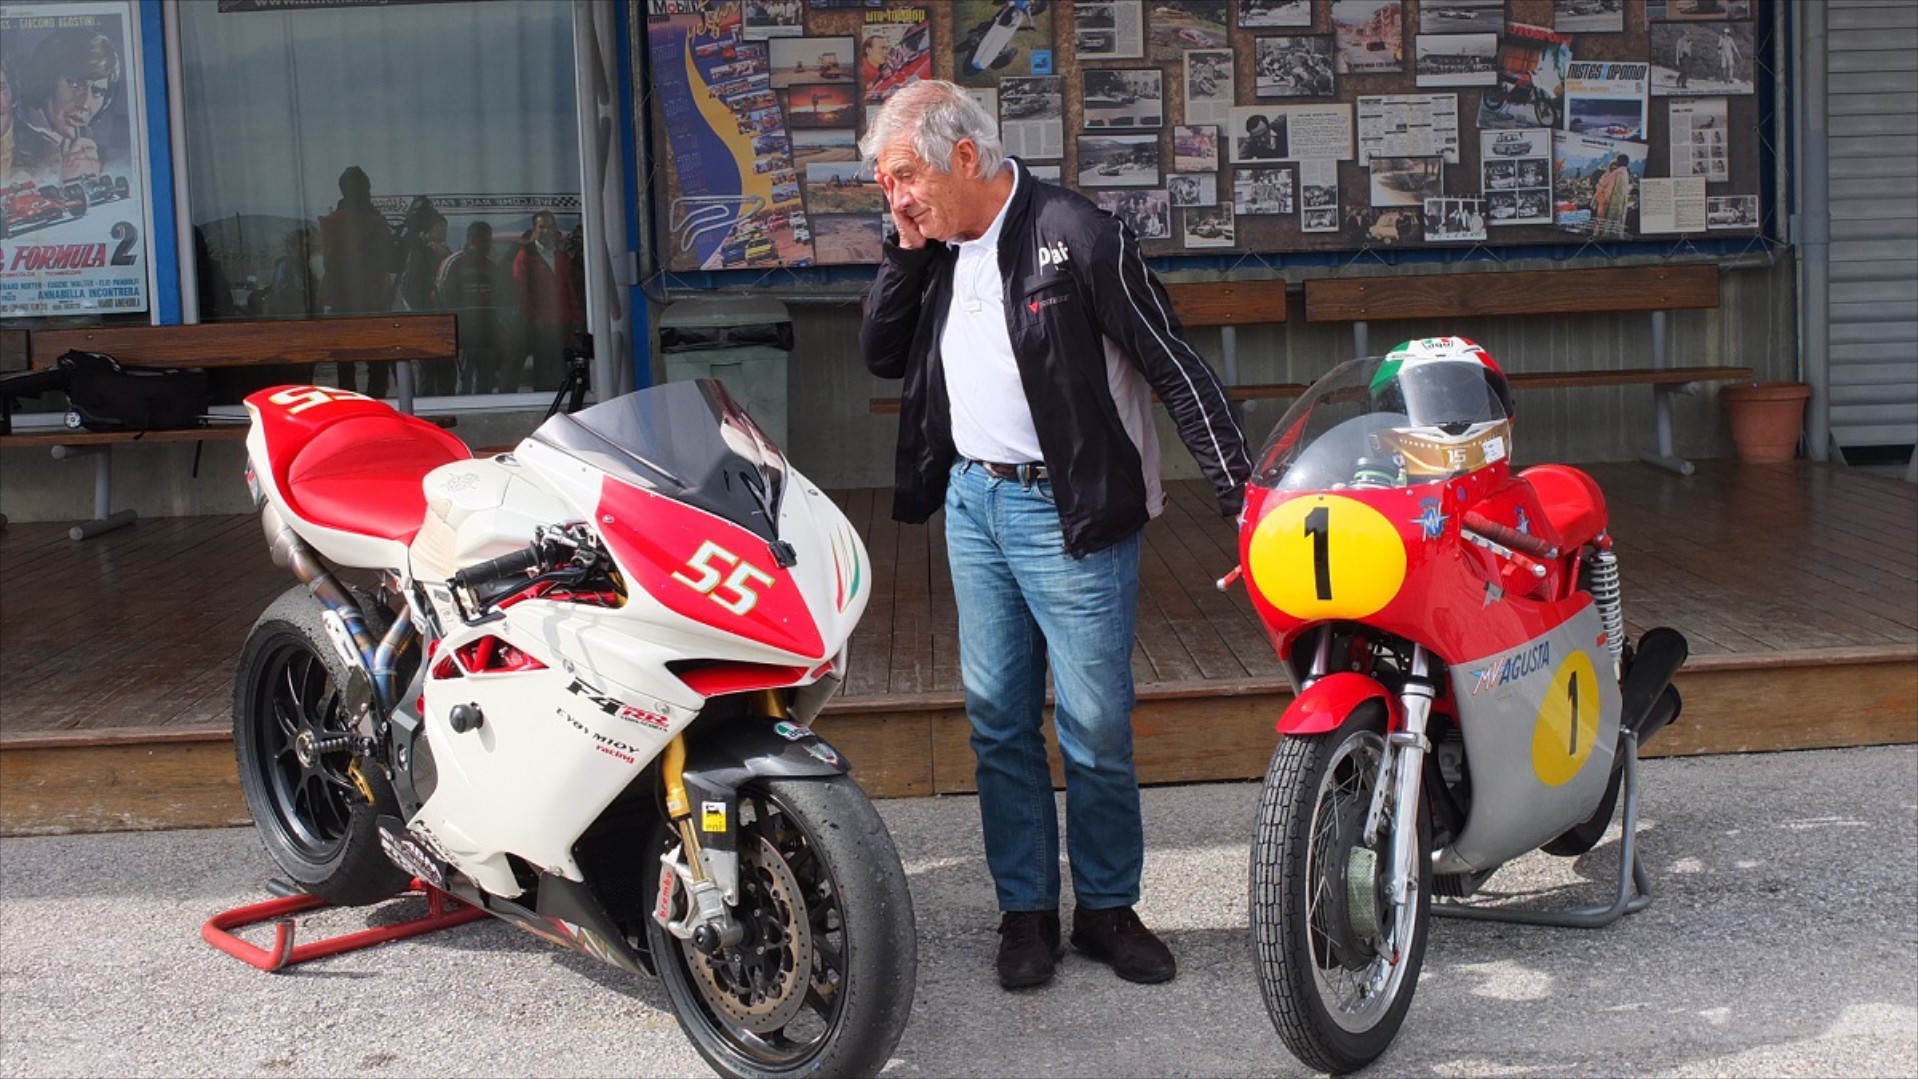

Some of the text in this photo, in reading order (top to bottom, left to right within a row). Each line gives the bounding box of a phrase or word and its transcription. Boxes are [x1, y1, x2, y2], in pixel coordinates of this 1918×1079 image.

[19, 18, 56, 29] GIACOMO
[58, 16, 96, 28] AGOSTINI
[10, 243, 107, 270] FORMULA
[110, 221, 138, 266] 2
[38, 286, 140, 300] ANNABELLA INCONTRERA
[1447, 448, 1467, 464] 15
[671, 539, 775, 616] 55
[1304, 506, 1333, 601] 1
[1567, 669, 1578, 756] 1
[595, 744, 636, 765] racing
[658, 871, 674, 919] brembo
